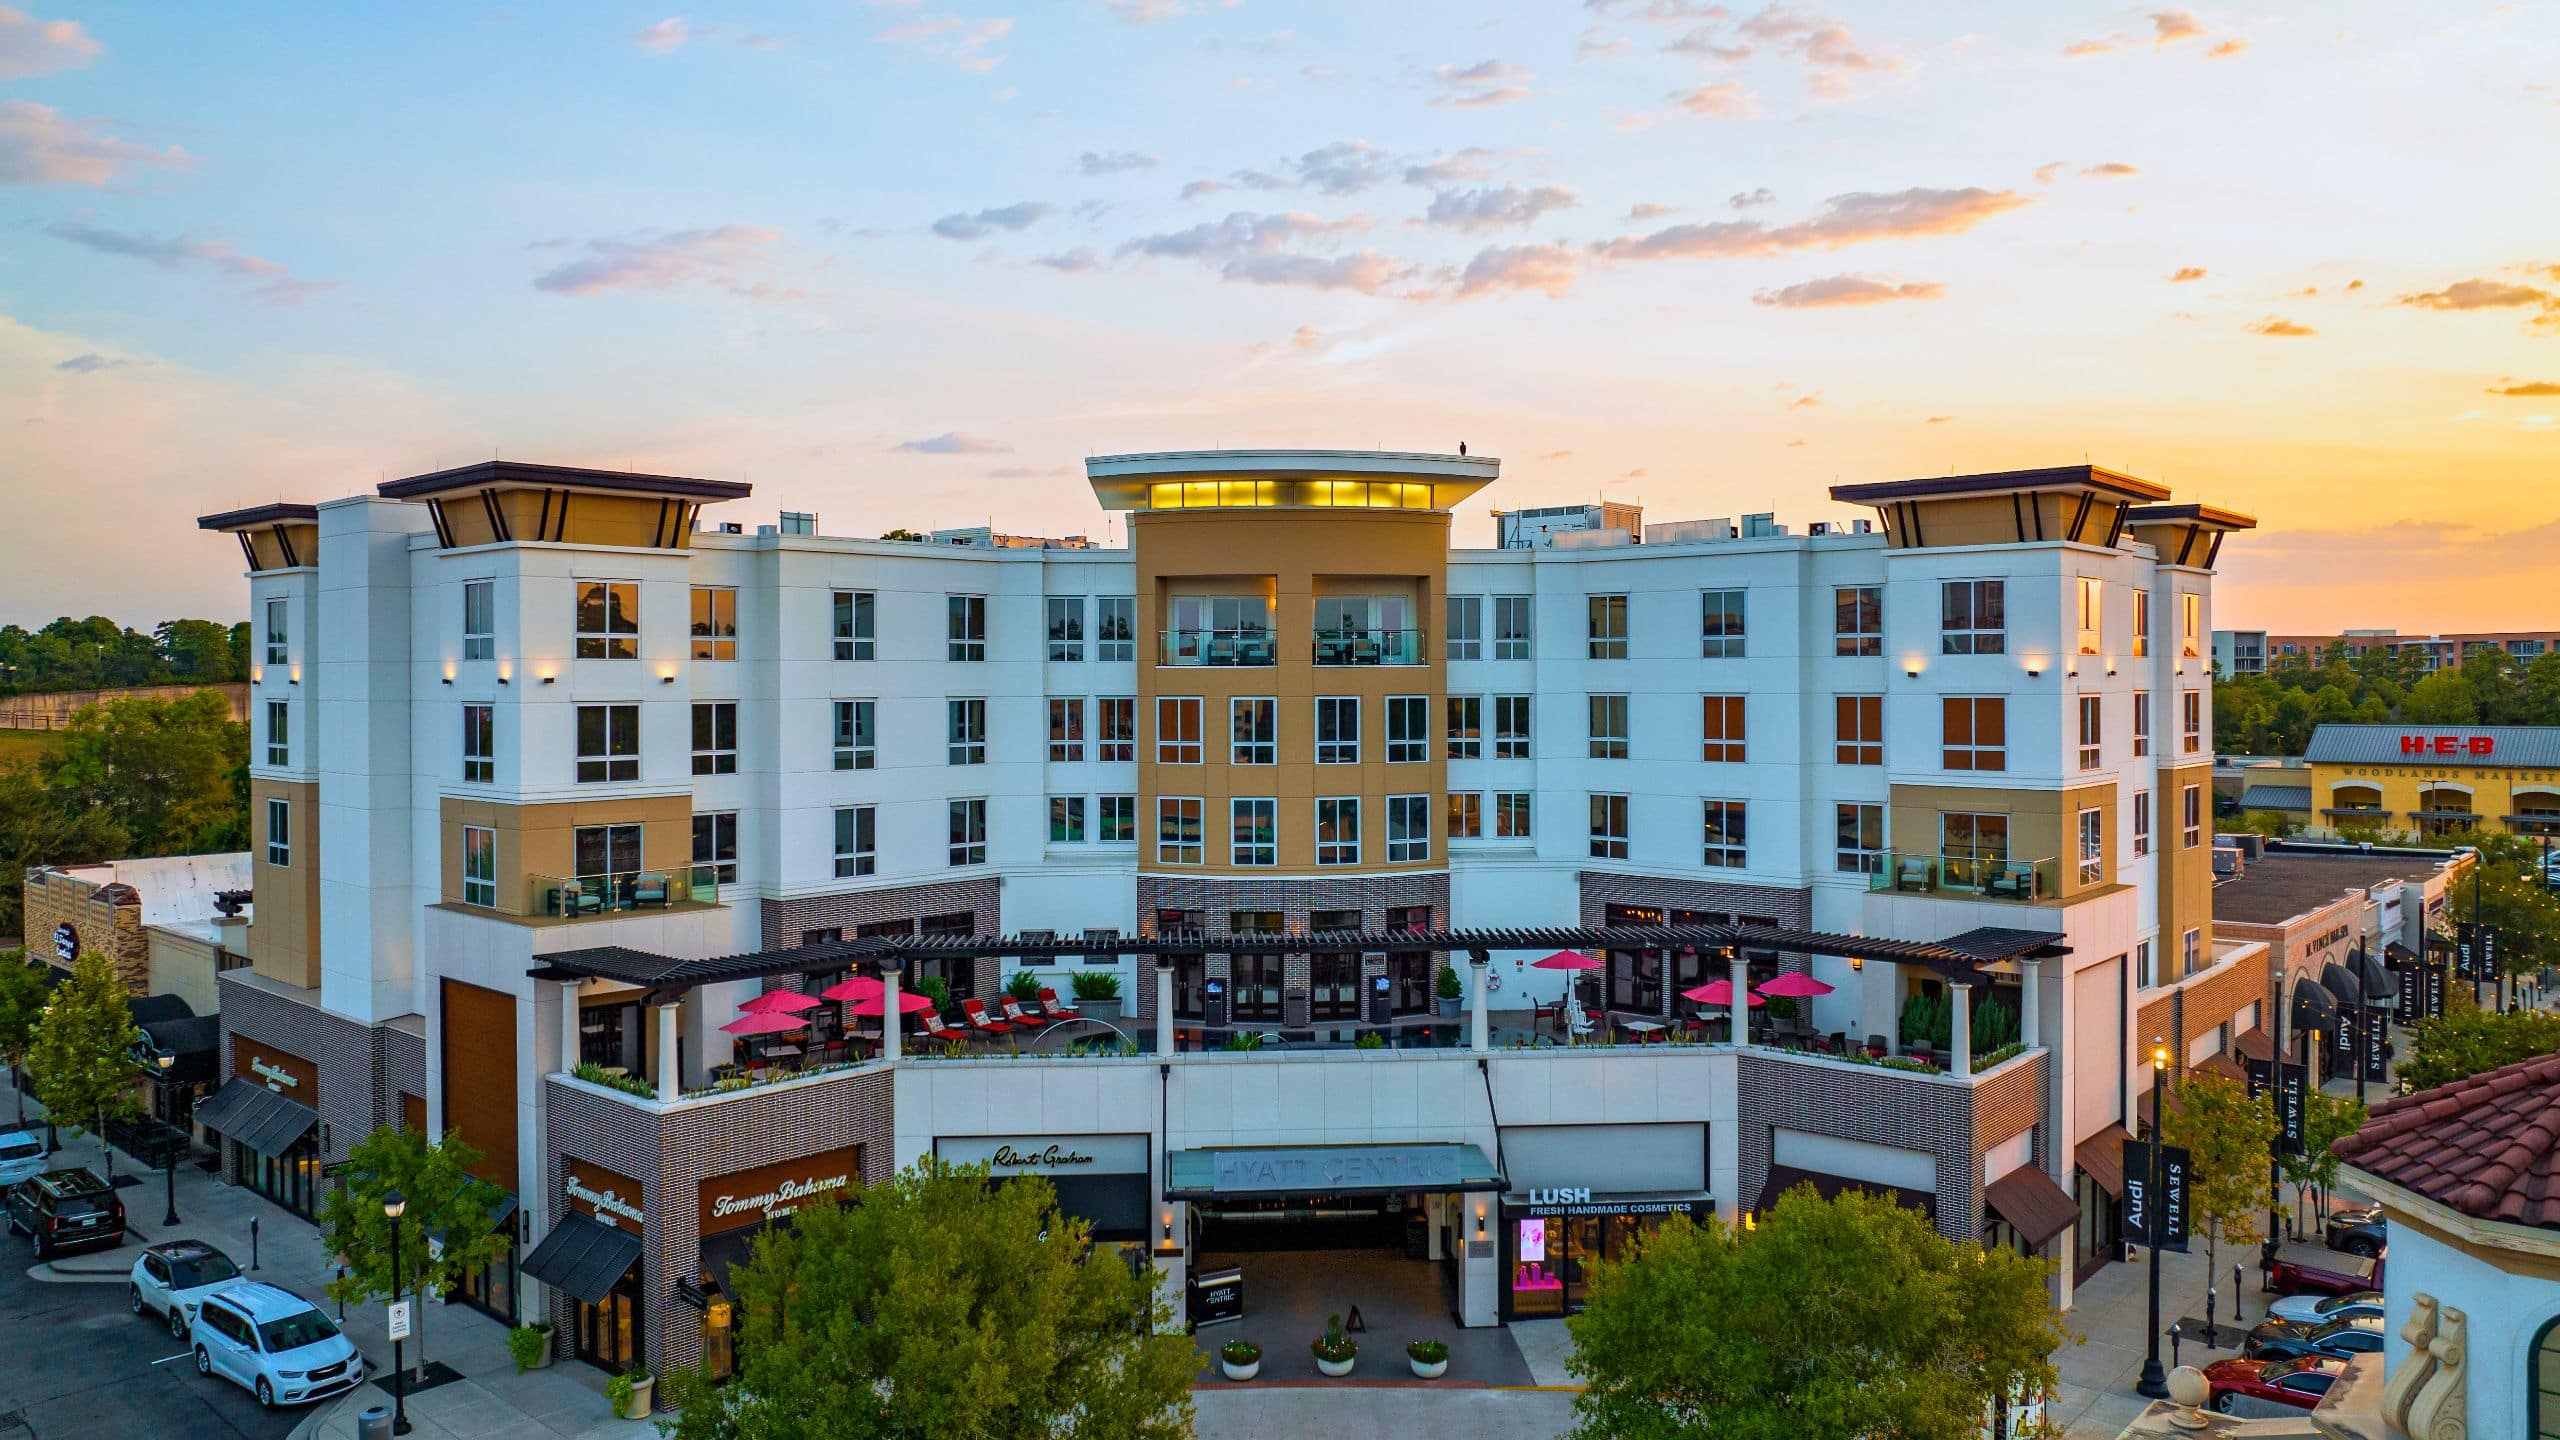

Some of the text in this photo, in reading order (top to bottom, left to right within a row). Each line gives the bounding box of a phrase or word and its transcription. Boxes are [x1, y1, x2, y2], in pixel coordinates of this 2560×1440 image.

[2401, 736, 2495, 755] H-E-B
[2342, 767, 2556, 782] WOODLANDS MARKET
[2460, 943, 2470, 971] Audi
[2484, 932, 2493, 974] SEWELL
[2404, 972, 2412, 1017] INFINITI
[2339, 1015, 2351, 1051] Audi
[2370, 1015, 2381, 1070] SEWELL
[2287, 1078, 2298, 1139] SEWELL
[993, 1144, 1094, 1168] Robert Graham
[1219, 1153, 1455, 1185] HYATT CENTRIC
[567, 1176, 602, 1213] Tommy
[712, 1192, 780, 1218] Tommy
[1529, 1187, 1591, 1206] LUSH
[1530, 1203, 1692, 1216] FRESH HANDMADE COSMETICS
[2128, 1179, 2143, 1230] Audi
[2168, 1163, 2181, 1236] SEWELL
[1210, 1288, 1231, 1298] HYATT
